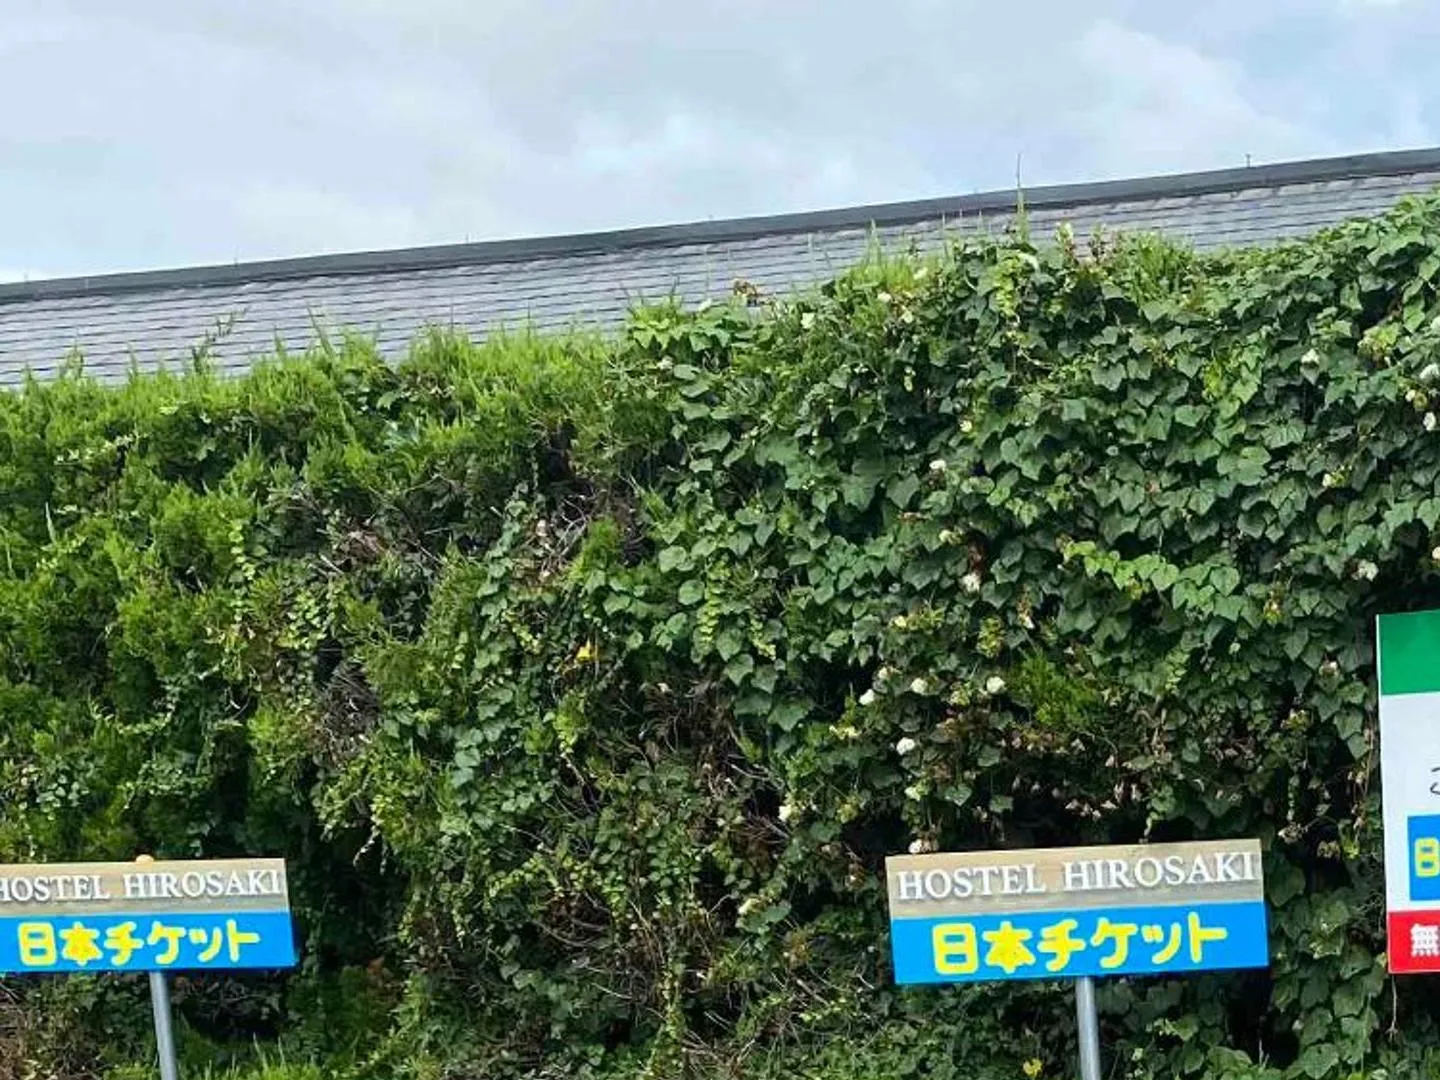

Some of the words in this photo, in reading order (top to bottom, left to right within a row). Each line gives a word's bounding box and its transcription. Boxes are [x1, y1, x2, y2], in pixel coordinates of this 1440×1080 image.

[122, 868, 280, 899] HIROSAKI
[899, 862, 1046, 900] HOSTEL
[1064, 850, 1258, 891] HIROSAKI
[17, 918, 261, 967] 日本チケット
[931, 911, 1228, 975] 日本チケット
